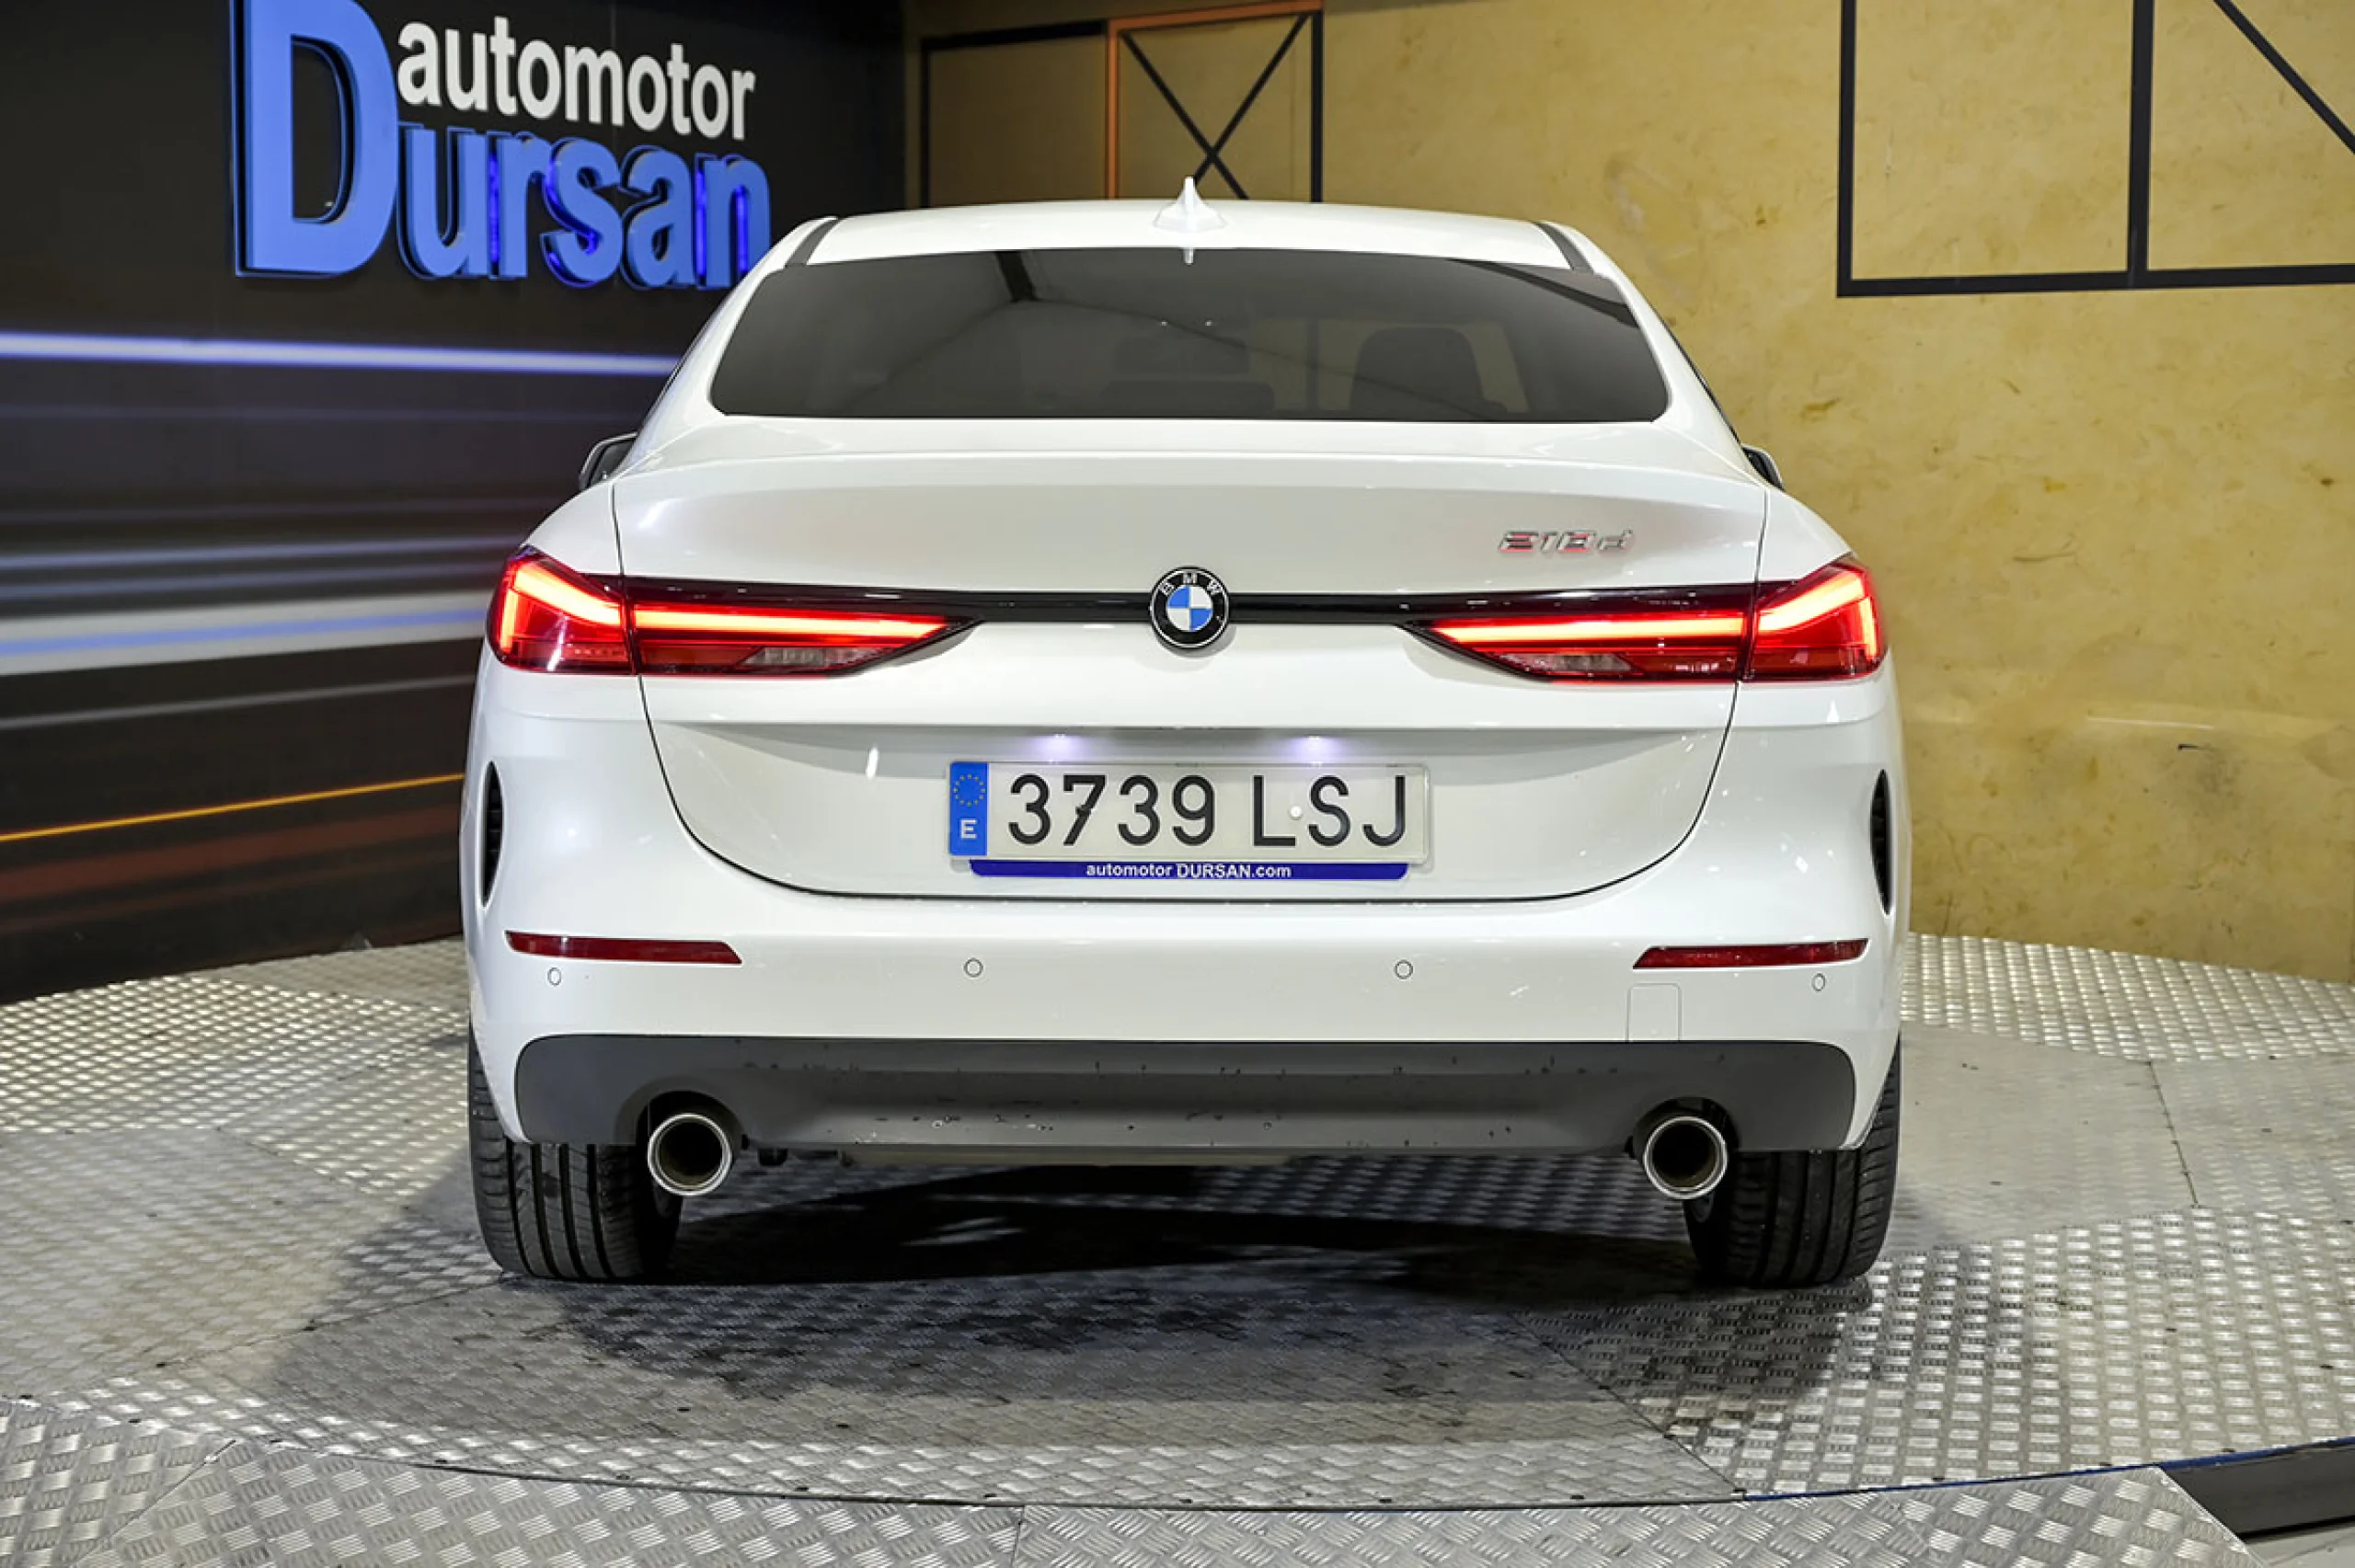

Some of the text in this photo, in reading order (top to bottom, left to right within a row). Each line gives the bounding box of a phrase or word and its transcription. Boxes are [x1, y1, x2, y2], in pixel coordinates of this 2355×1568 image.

[396, 16, 756, 141] automotor
[232, 0, 772, 290] Dursan
[1159, 571, 1223, 597] BMW
[959, 818, 977, 840] E
[1008, 773, 1406, 847] 3739 LSJ
[1086, 863, 1292, 879] automotor DURSAN.com
